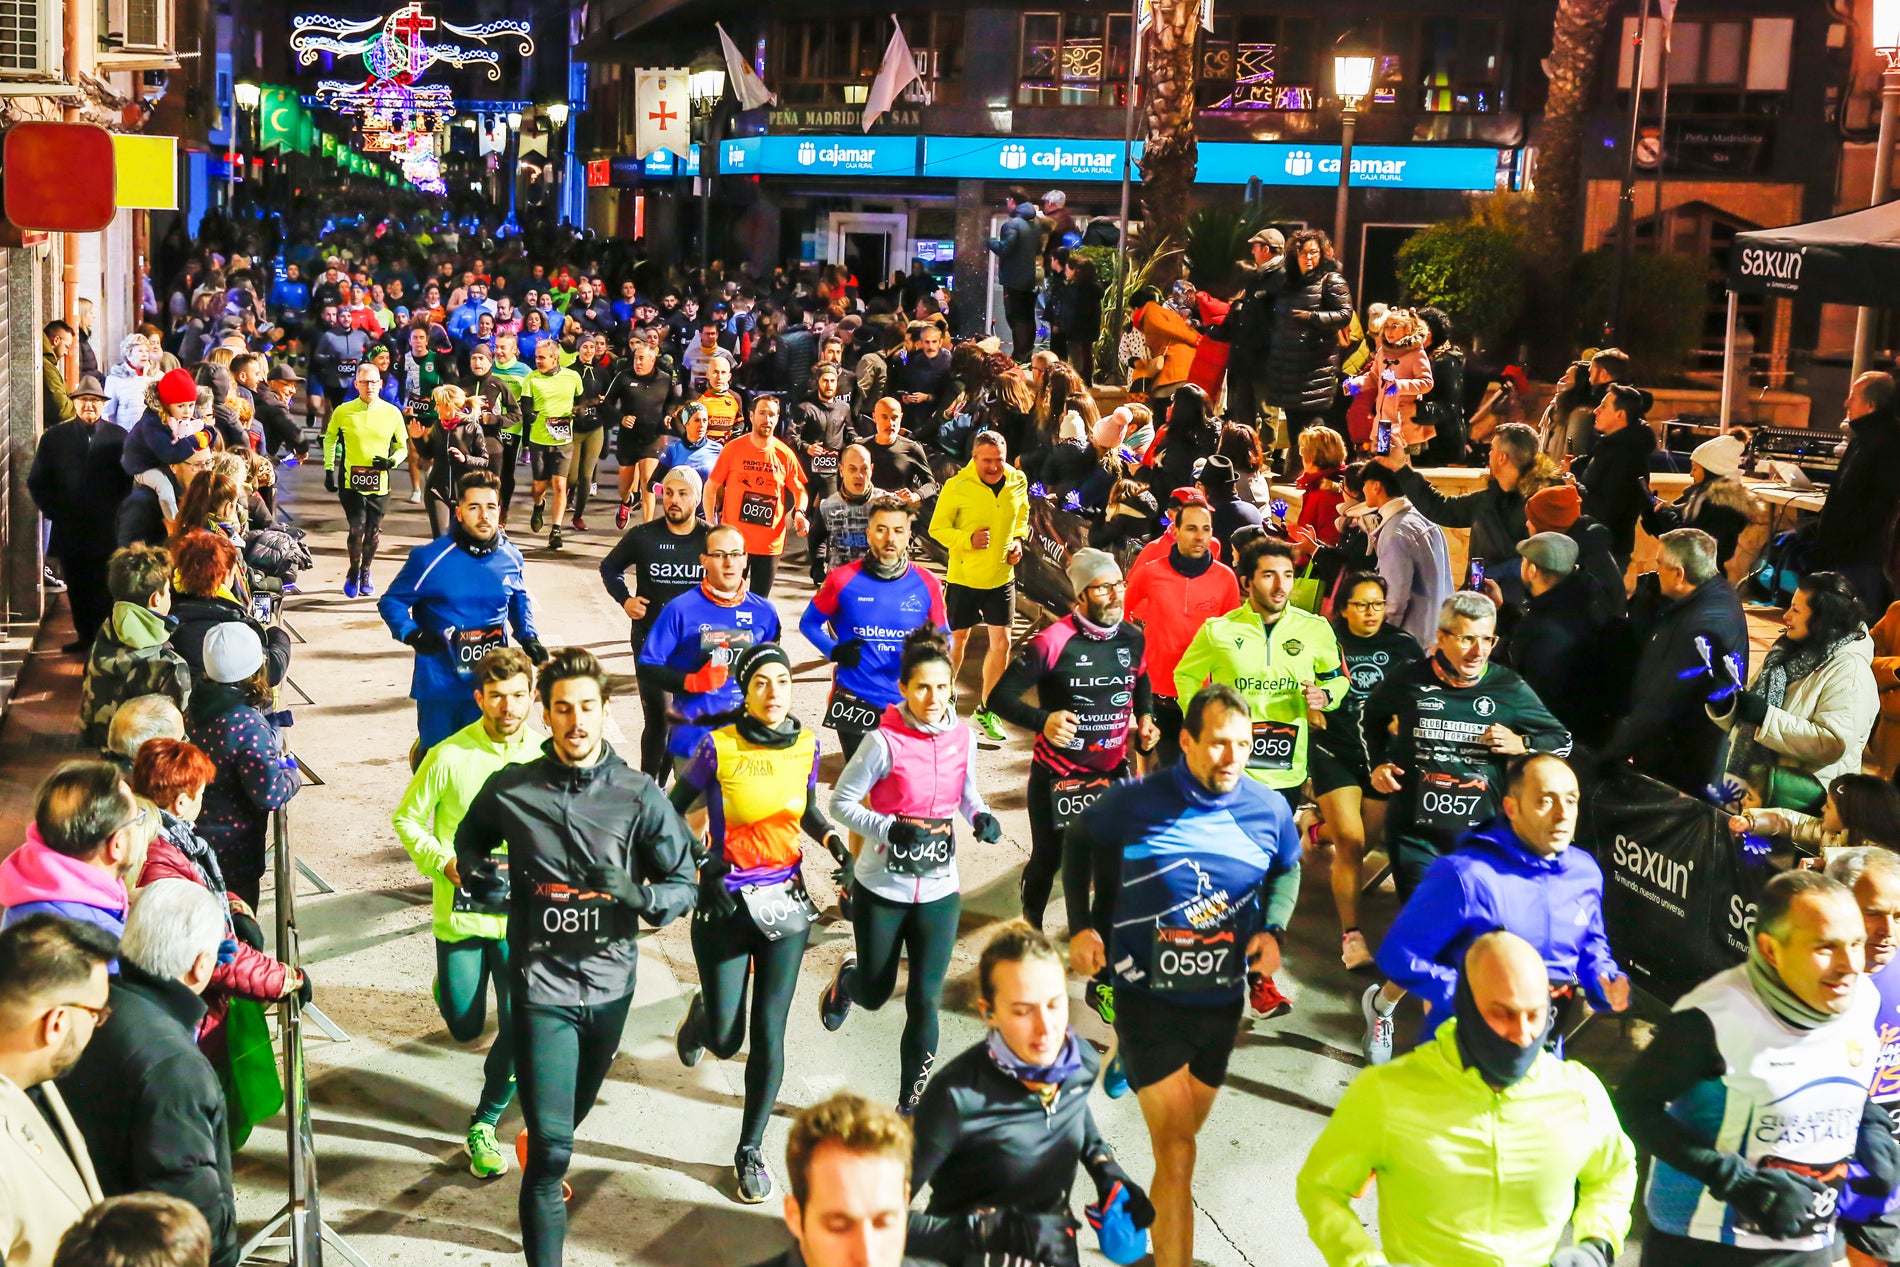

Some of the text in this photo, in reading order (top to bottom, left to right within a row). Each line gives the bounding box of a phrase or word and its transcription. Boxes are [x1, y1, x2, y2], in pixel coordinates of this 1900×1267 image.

[769, 107, 798, 126] PEÑA
[893, 109, 921, 126] SAX
[819, 143, 876, 168] cajamar
[1031, 147, 1117, 172] cajamar
[1318, 158, 1406, 174] caamar
[1360, 173, 1378, 181] CAJA
[337, 364, 356, 373] 0954
[408, 400, 429, 411] 0070
[813, 456, 837, 467] 0953
[352, 474, 379, 486] 0903
[743, 502, 773, 519] 0870
[877, 643, 896, 652] fibra
[1070, 675, 1135, 687] ILICAR
[1248, 677, 1299, 690] FacePhi
[831, 701, 876, 727] 0470
[1420, 717, 1441, 728] CLUB
[1413, 727, 1445, 740] PUERTO
[1057, 793, 1102, 815] 059
[1422, 791, 1482, 815] 0857
[1613, 834, 1689, 900] saxun
[1640, 887, 1661, 904] nuestro
[543, 907, 600, 933] 0811
[1727, 933, 1751, 955] Tu mun
[1160, 948, 1230, 976] 0597
[909, 1051, 935, 1105] ROXY
